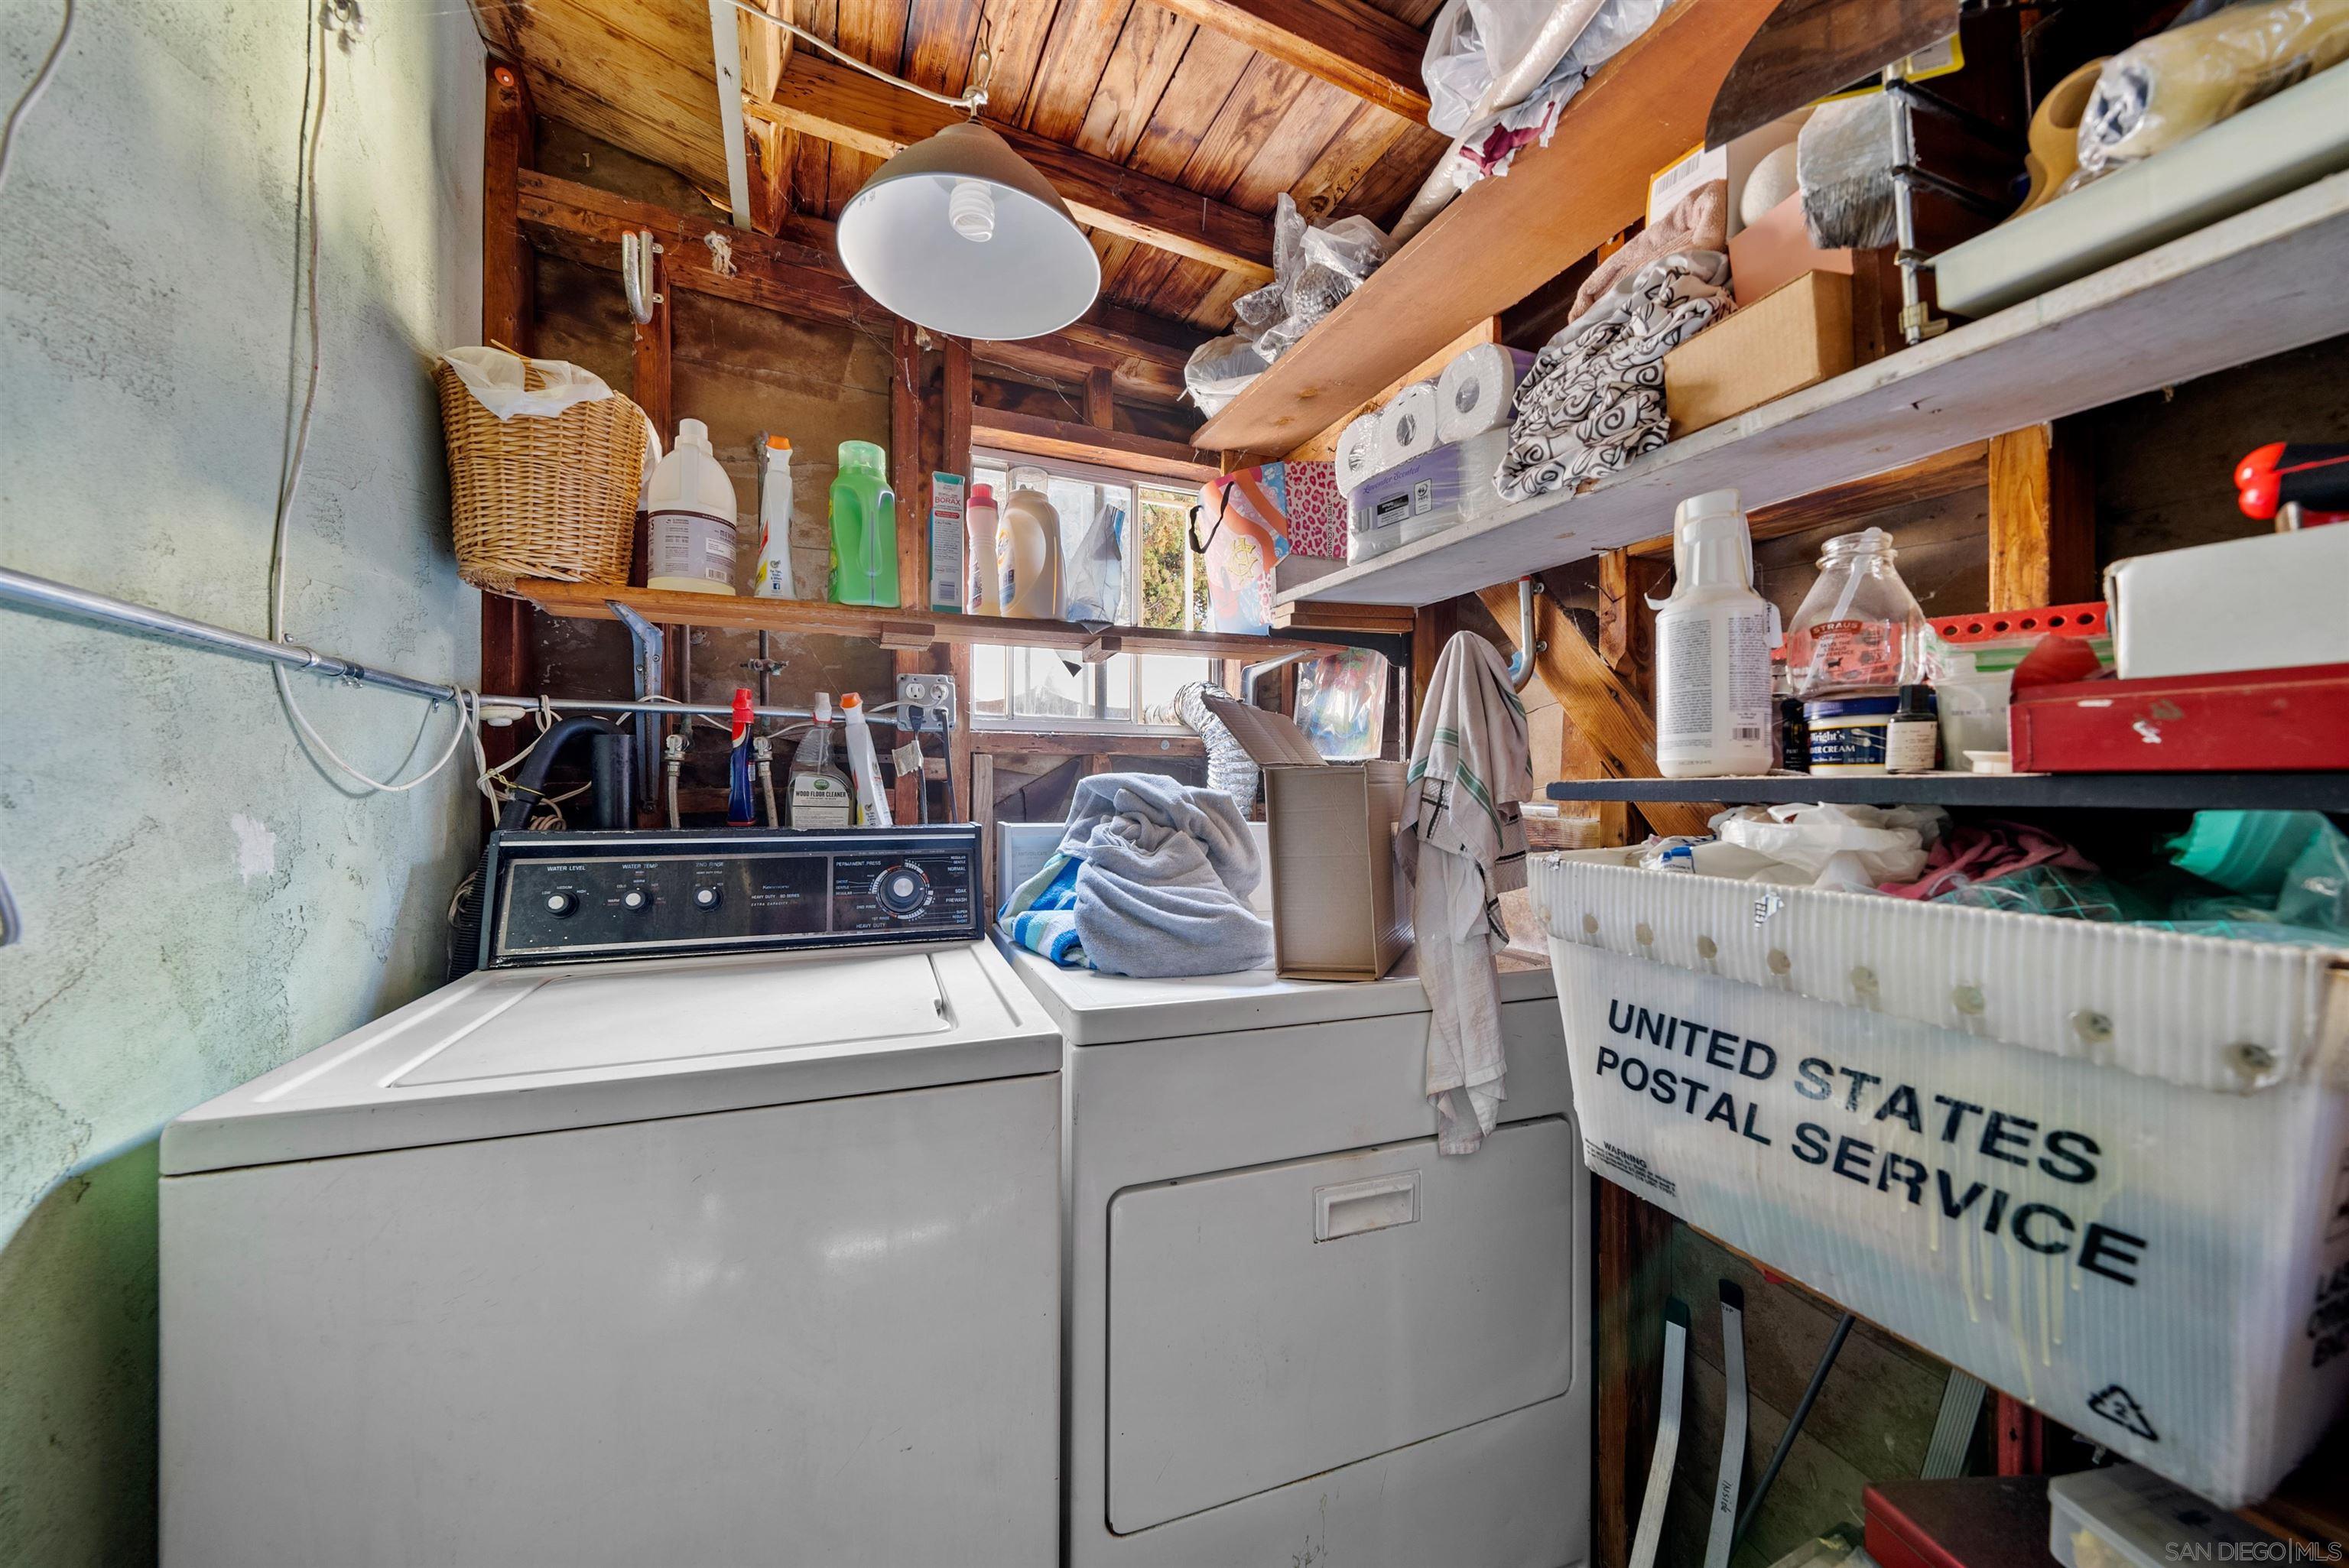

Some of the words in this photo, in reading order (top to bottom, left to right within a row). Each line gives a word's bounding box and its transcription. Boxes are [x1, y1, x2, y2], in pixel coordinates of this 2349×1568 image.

[1363, 476, 1392, 495] Lavender
[1393, 464, 1421, 480] Scented
[934, 496, 961, 507] BORAX
[1812, 622, 1858, 635] STRAUS
[1816, 650, 1854, 658] DIFFERENCE
[1822, 745, 1856, 754] CREAM
[1608, 998, 1778, 1081] UNITED
[1794, 1057, 2102, 1184] STATES
[1603, 1140, 1647, 1169] WARNING
[1597, 1045, 1772, 1147] POSTAL
[1792, 1122, 2147, 1287] SERVICE
